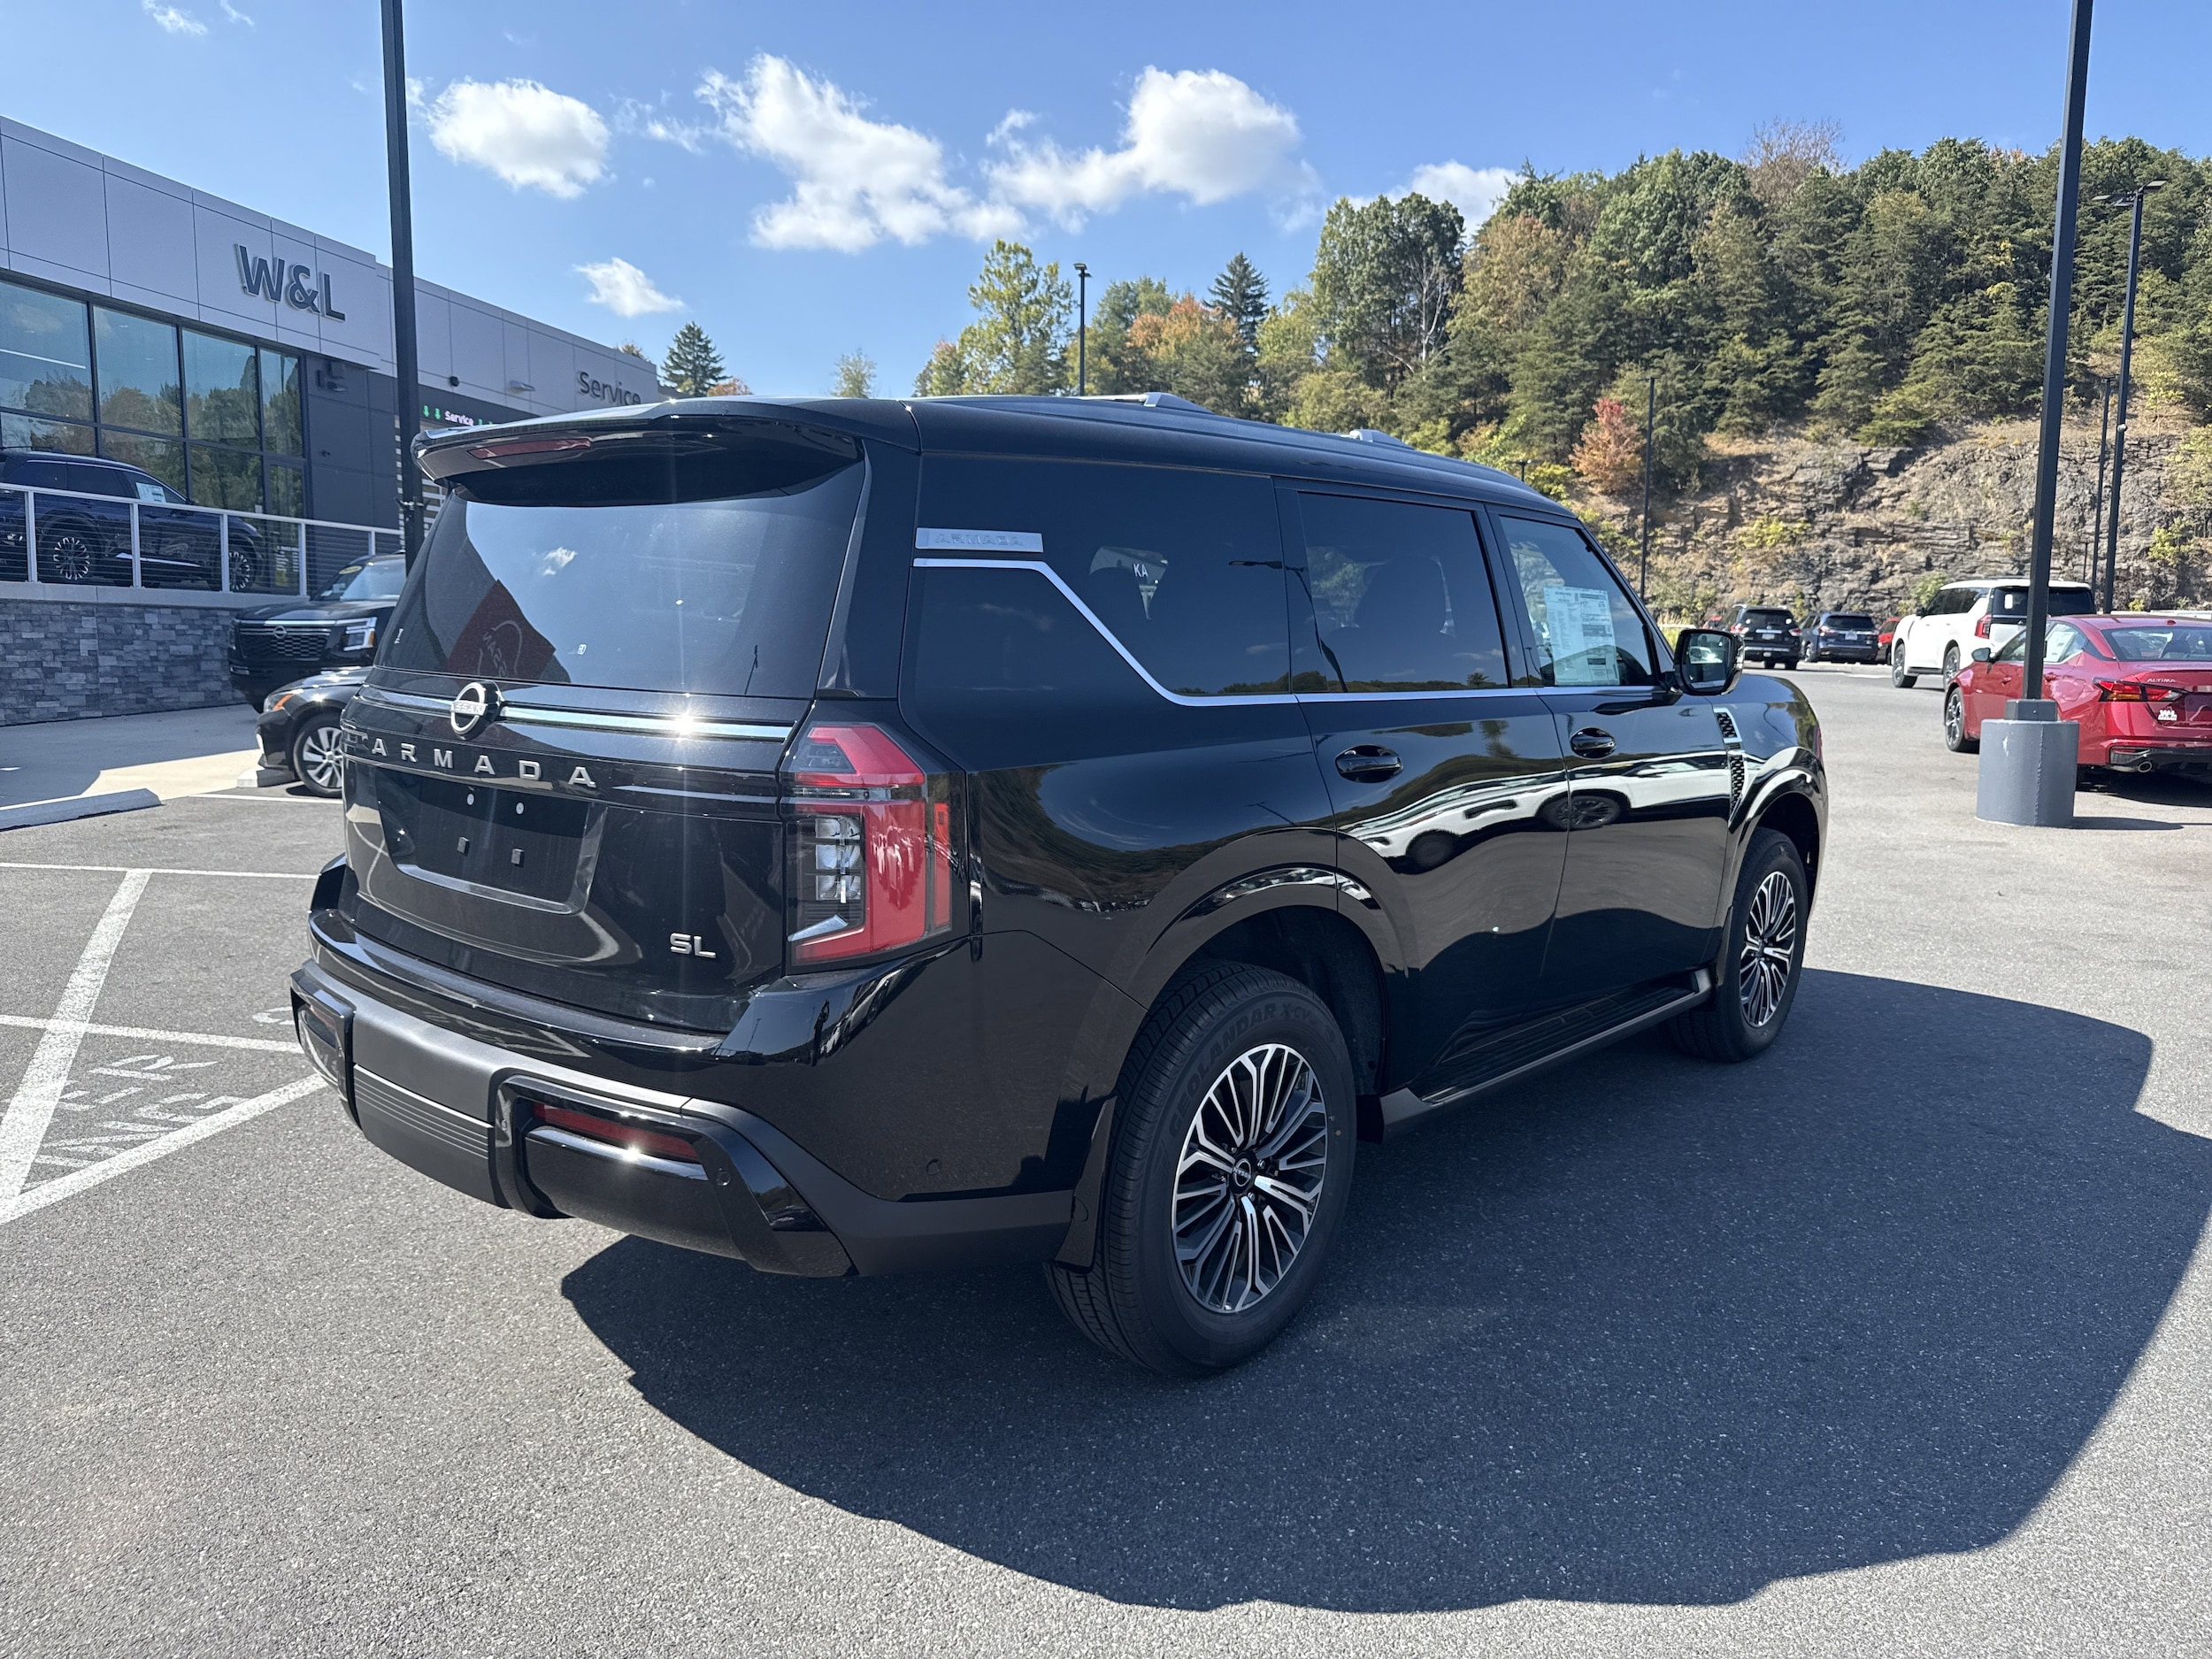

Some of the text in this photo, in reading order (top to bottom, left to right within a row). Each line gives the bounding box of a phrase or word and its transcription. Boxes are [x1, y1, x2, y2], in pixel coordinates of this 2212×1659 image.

[234, 243, 345, 322] W&L
[577, 371, 641, 404] Service
[444, 410, 475, 426] Service
[934, 534, 1025, 547] ARMADA
[371, 737, 597, 789] ARMADA
[670, 933, 717, 958] SL
[1169, 1002, 1276, 1137] GEOLANDAR
